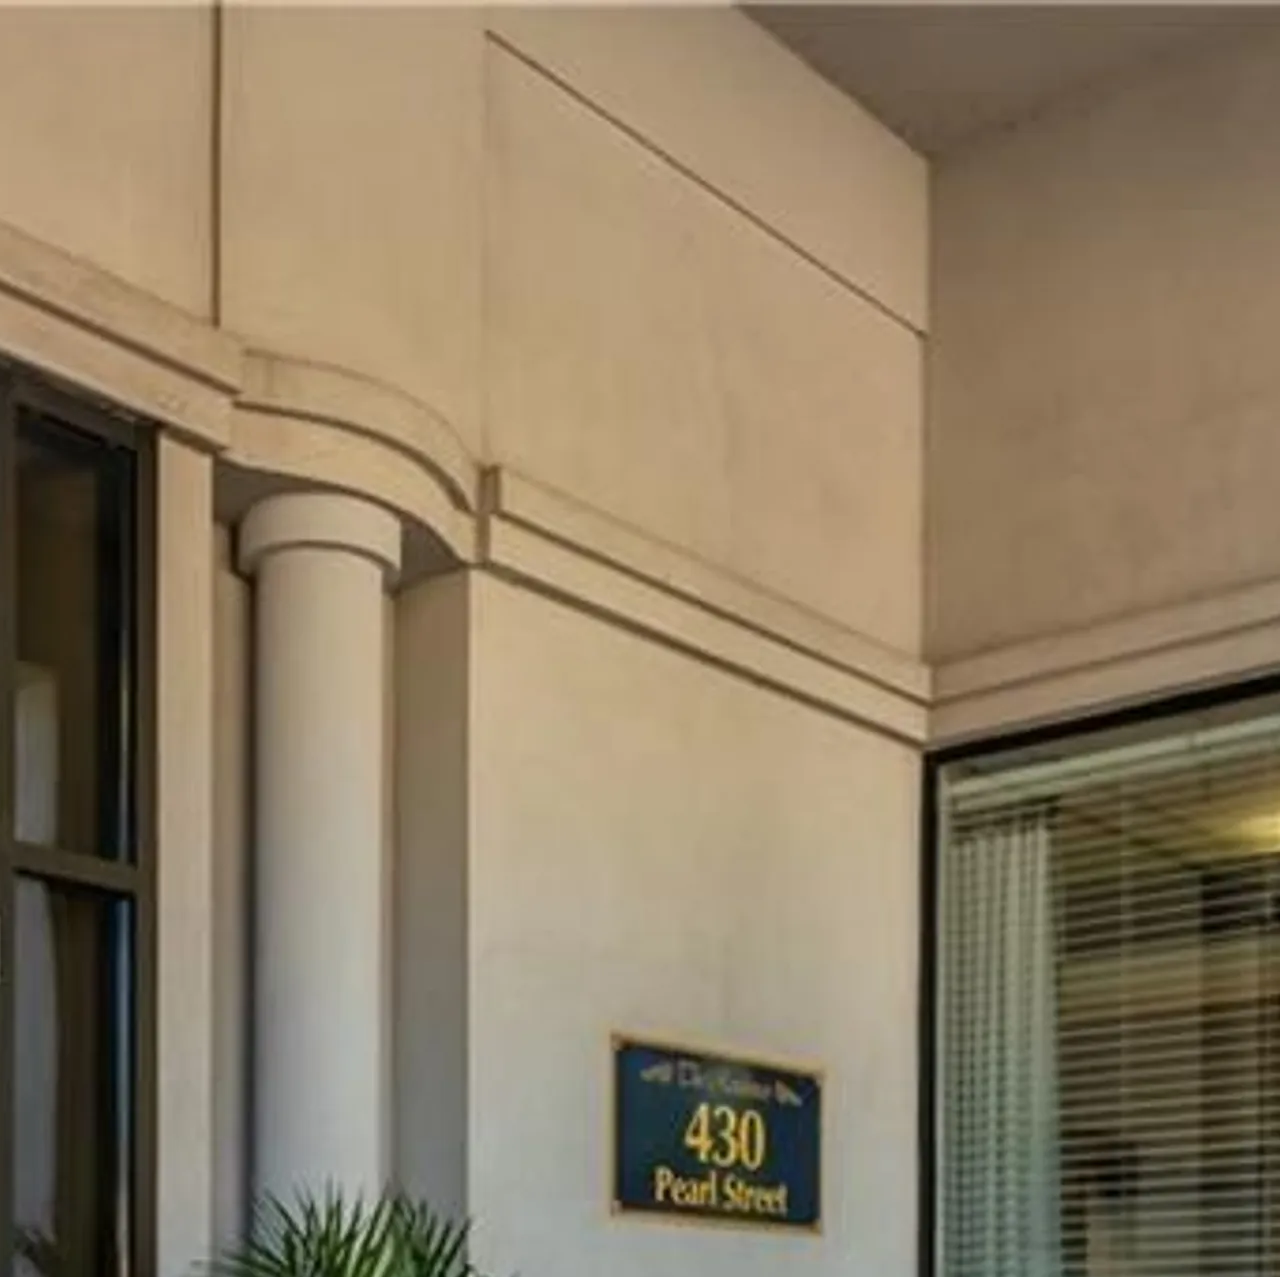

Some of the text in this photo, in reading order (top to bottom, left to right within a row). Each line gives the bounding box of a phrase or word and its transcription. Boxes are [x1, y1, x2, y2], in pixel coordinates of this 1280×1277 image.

[684, 1102, 766, 1171] 430
[654, 1165, 789, 1215] Pearl Street
